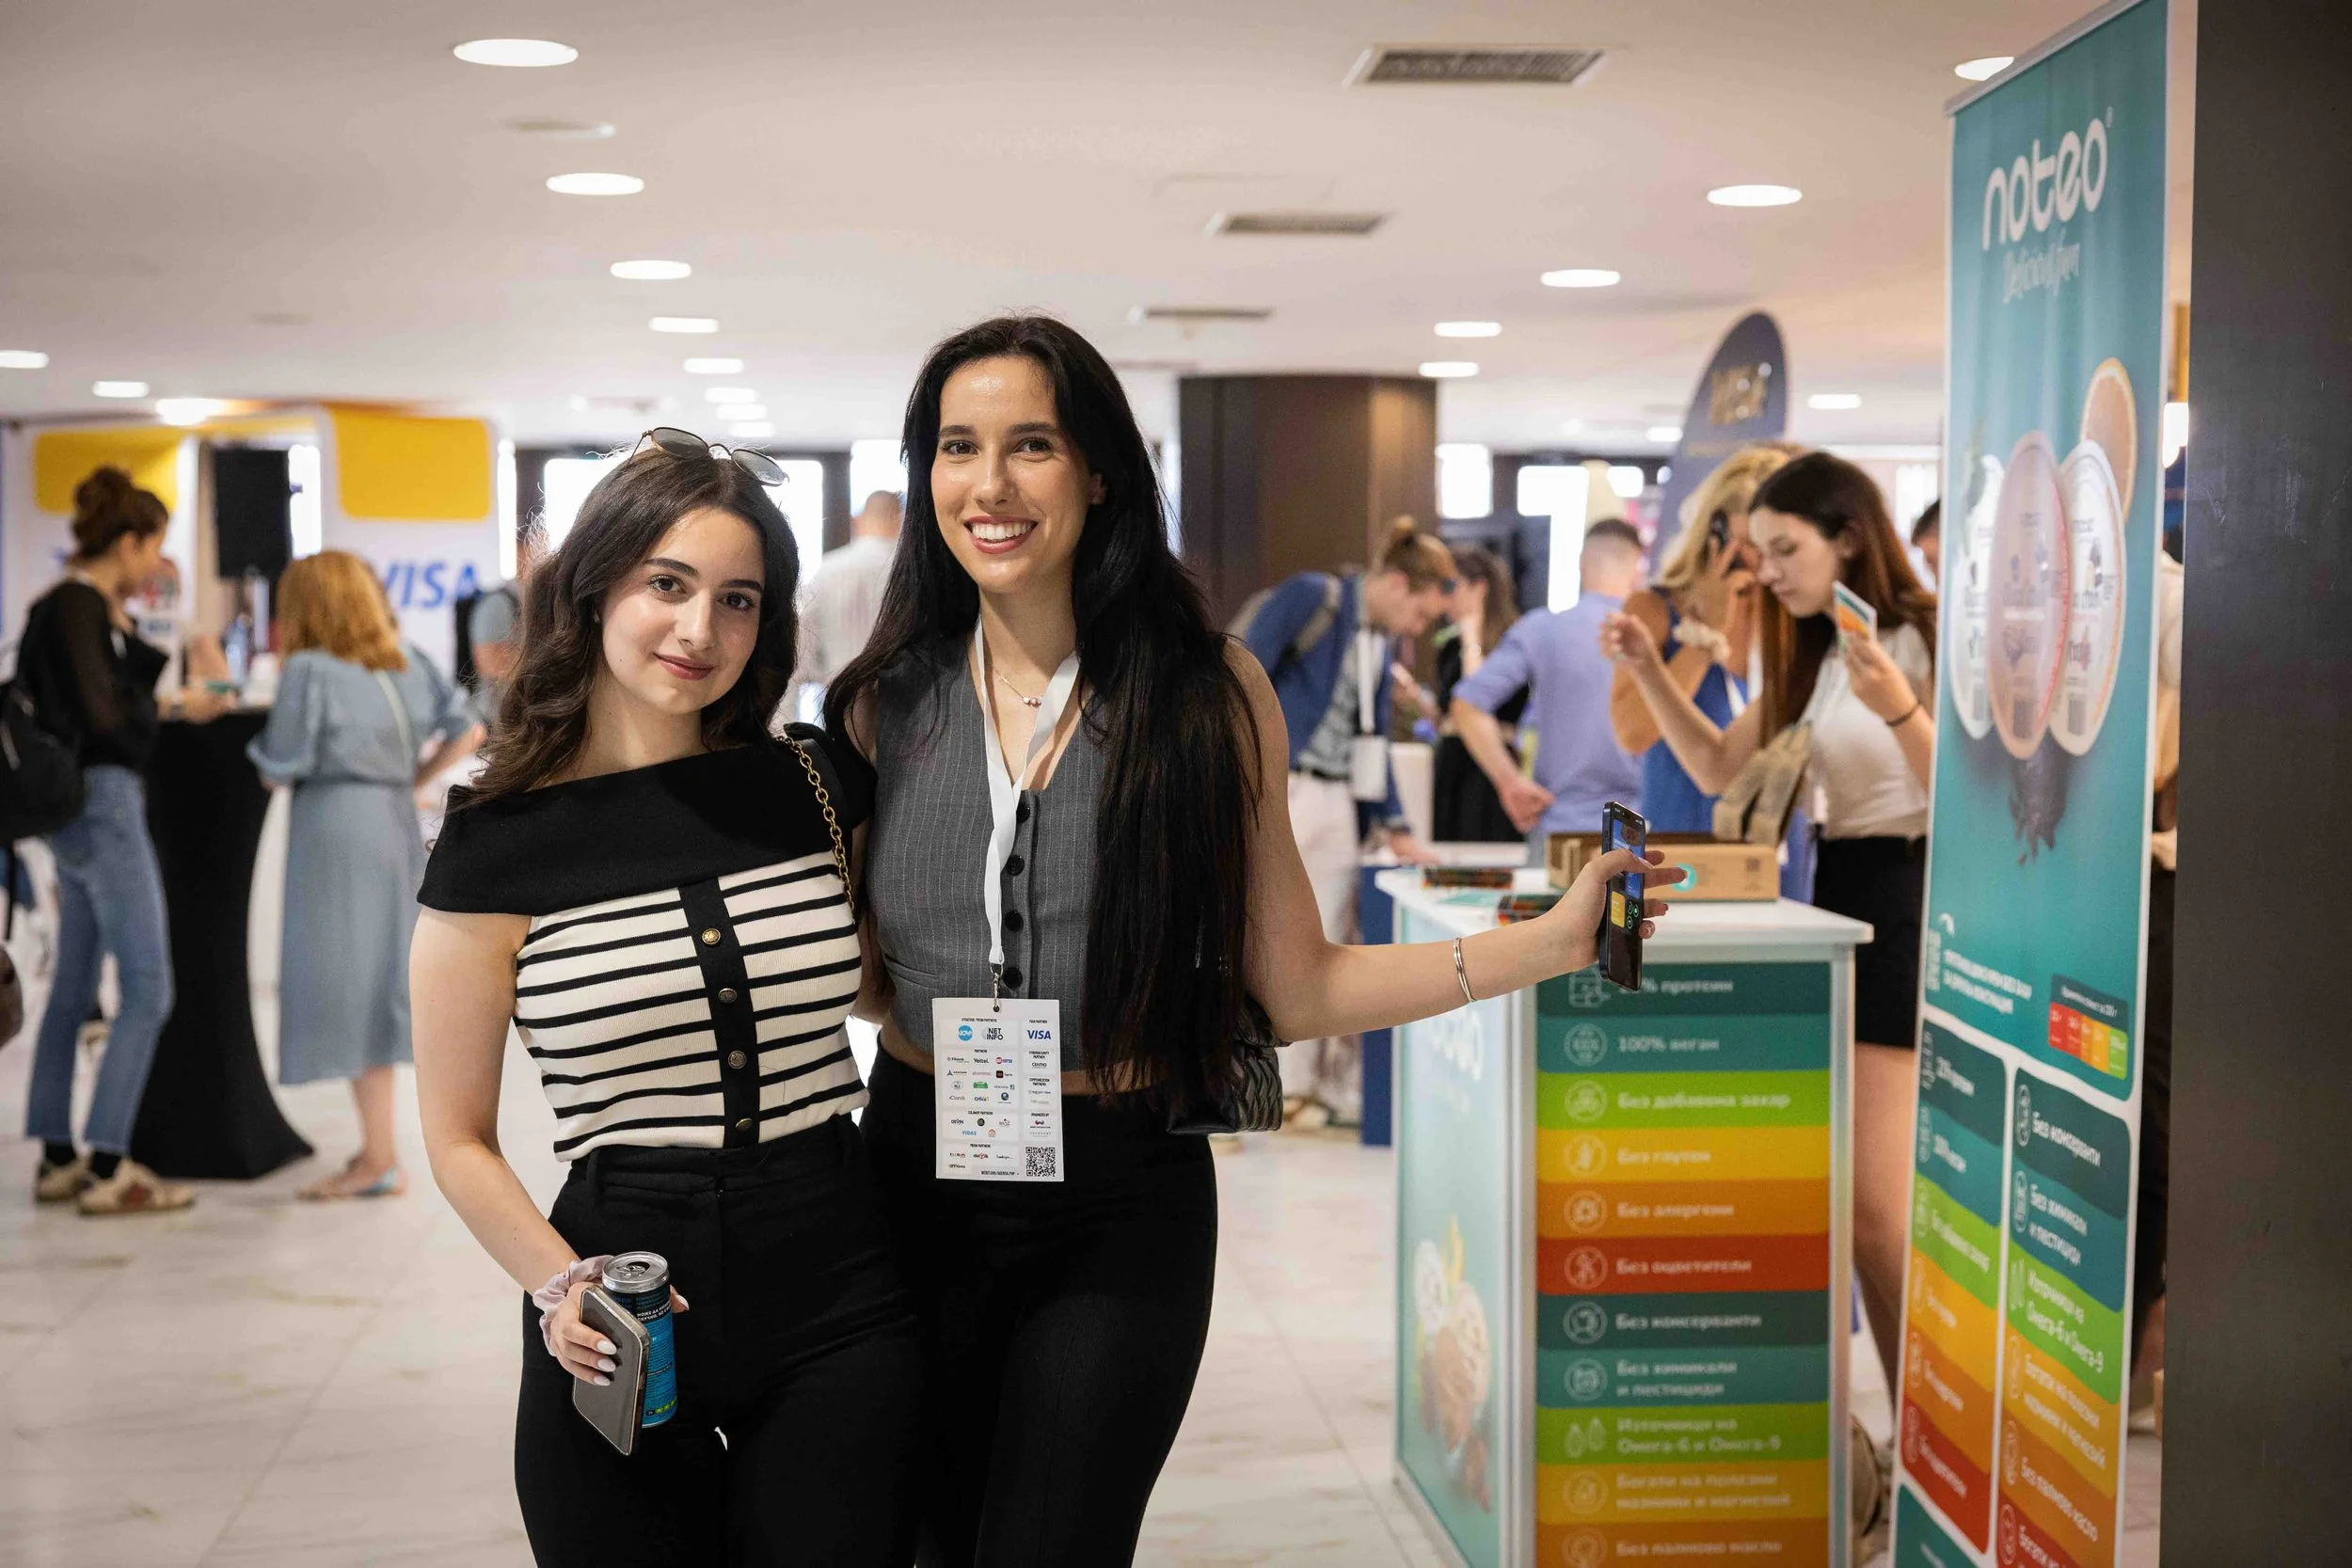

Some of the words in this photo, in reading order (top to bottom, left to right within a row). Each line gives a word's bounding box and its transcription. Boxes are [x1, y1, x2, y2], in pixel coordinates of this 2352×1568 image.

[1981, 118, 2107, 252] noteo
[1026, 1030, 1051, 1039] VISA
[1619, 1036, 1666, 1052] 100%
[1618, 1092, 1650, 1108] Без
[2032, 1111, 2049, 1139] Без
[2050, 1126, 2101, 1166] консерванти
[1617, 1148, 1649, 1164] Без
[2030, 1183, 2047, 1212] Без
[1617, 1202, 1650, 1218] Без
[1616, 1259, 1648, 1274] Без
[1615, 1313, 1648, 1329] Без
[1616, 1360, 1648, 1375] Без
[1616, 1540, 1649, 1556] Без
